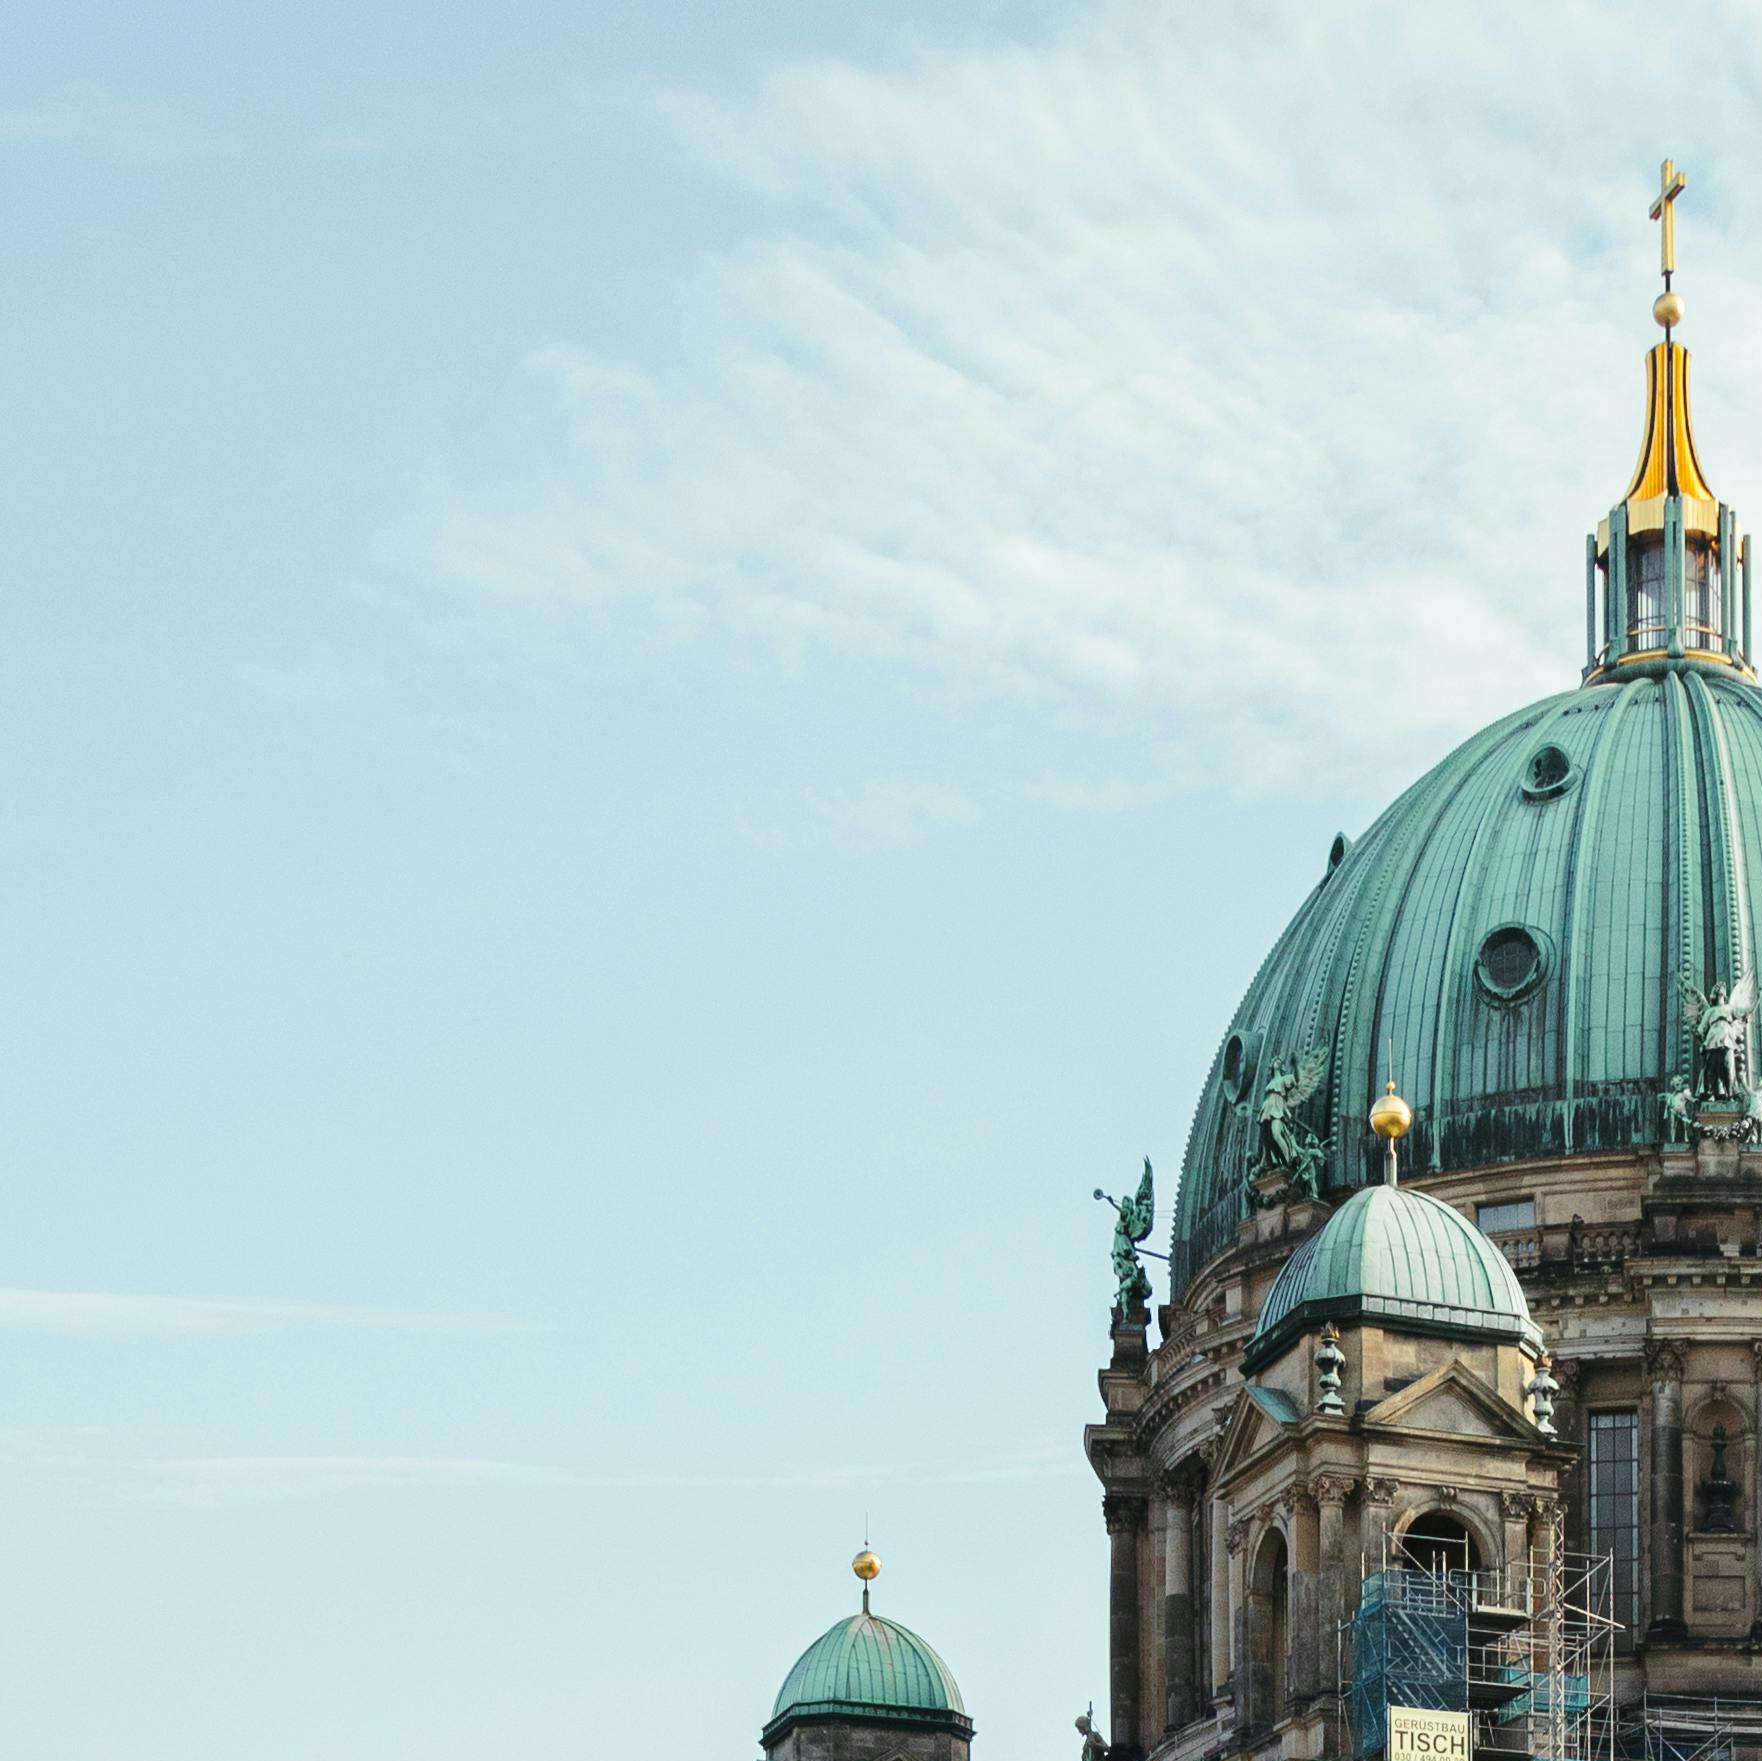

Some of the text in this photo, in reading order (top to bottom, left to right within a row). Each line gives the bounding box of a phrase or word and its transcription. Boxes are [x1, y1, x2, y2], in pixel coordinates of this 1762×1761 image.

[1394, 1718, 1465, 1734] GERÜSTBAU
[1394, 1730, 1465, 1756] TISCH
[1394, 1752, 1411, 1761] 030
